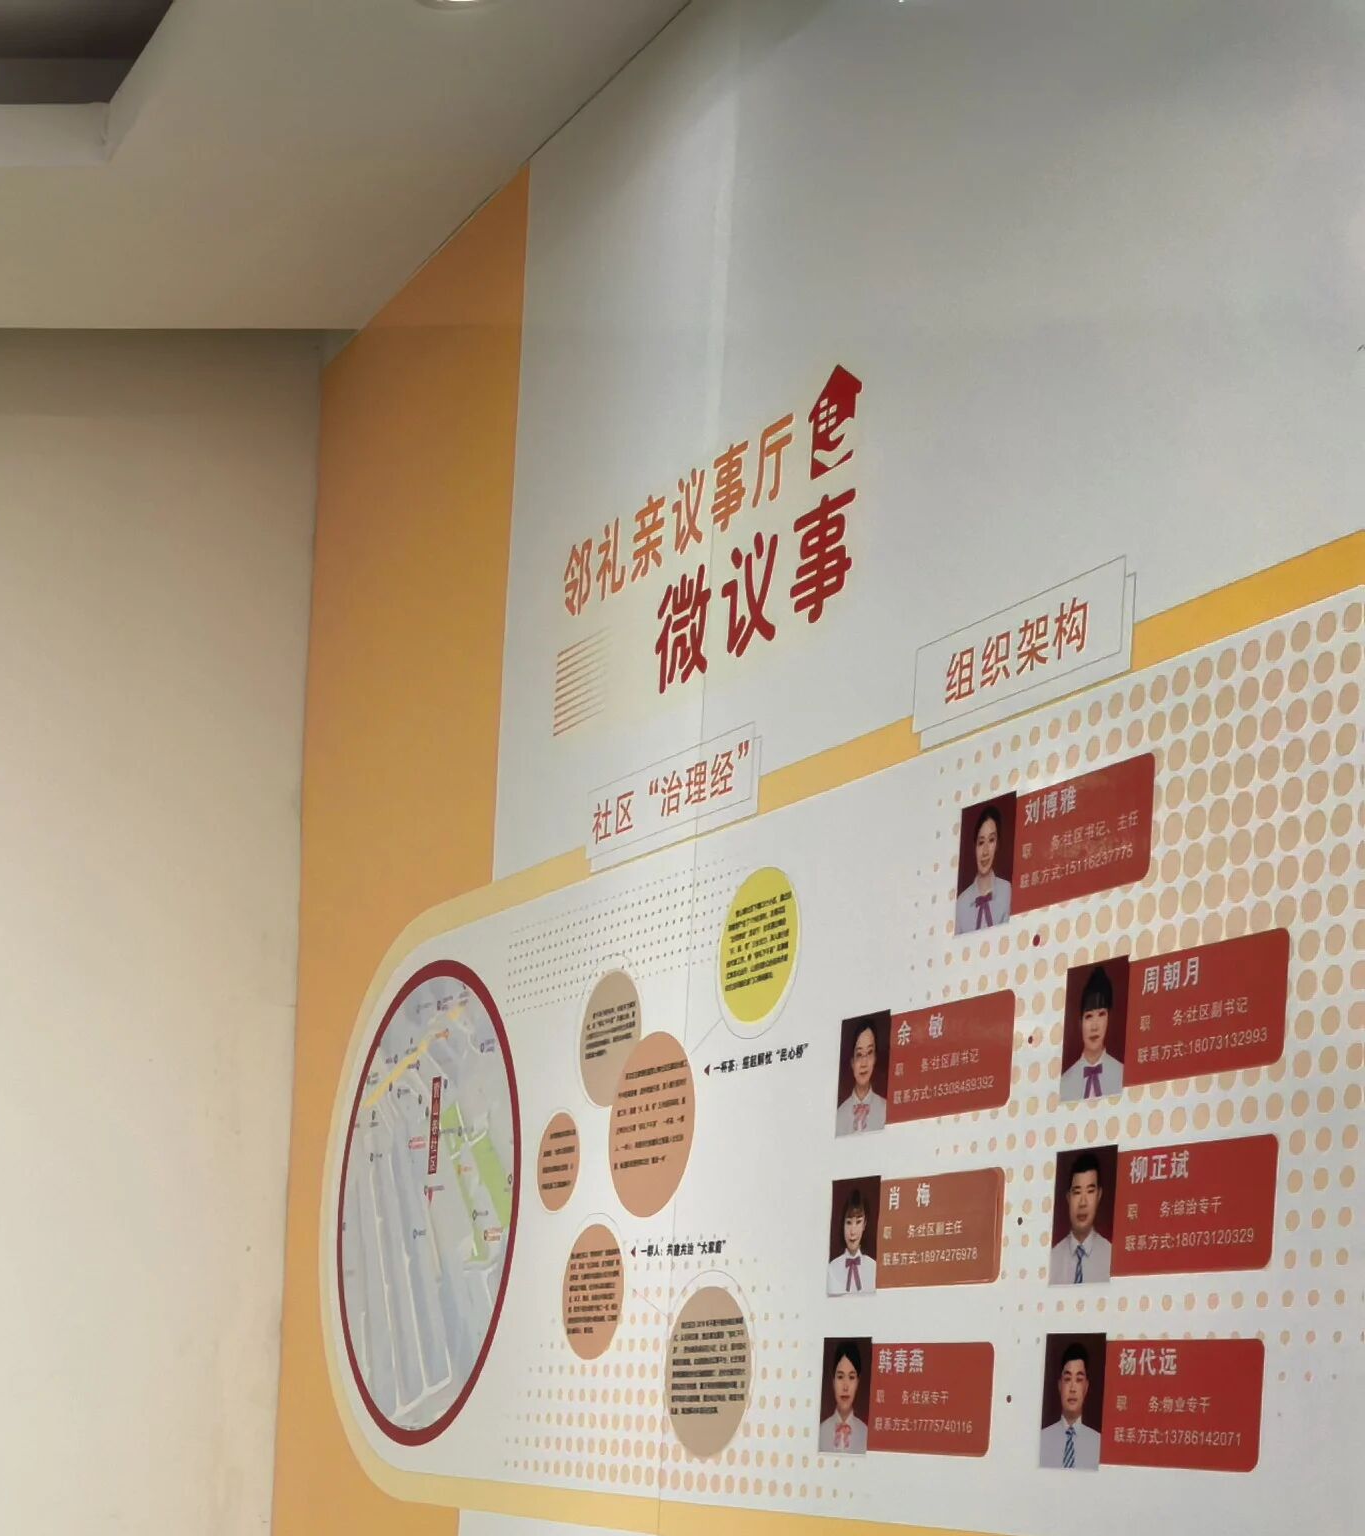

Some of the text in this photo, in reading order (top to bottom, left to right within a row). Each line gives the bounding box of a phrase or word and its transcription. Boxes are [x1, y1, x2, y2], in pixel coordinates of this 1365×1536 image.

[563, 413, 794, 616] 邻礼亲议事厅
[655, 487, 857, 695] 微议事
[943, 596, 1089, 704] 组织架构
[1141, 956, 1201, 996] 周朝月
[1129, 1150, 1190, 1185] 柳正斌
[1119, 1348, 1178, 1376] 杨代远
